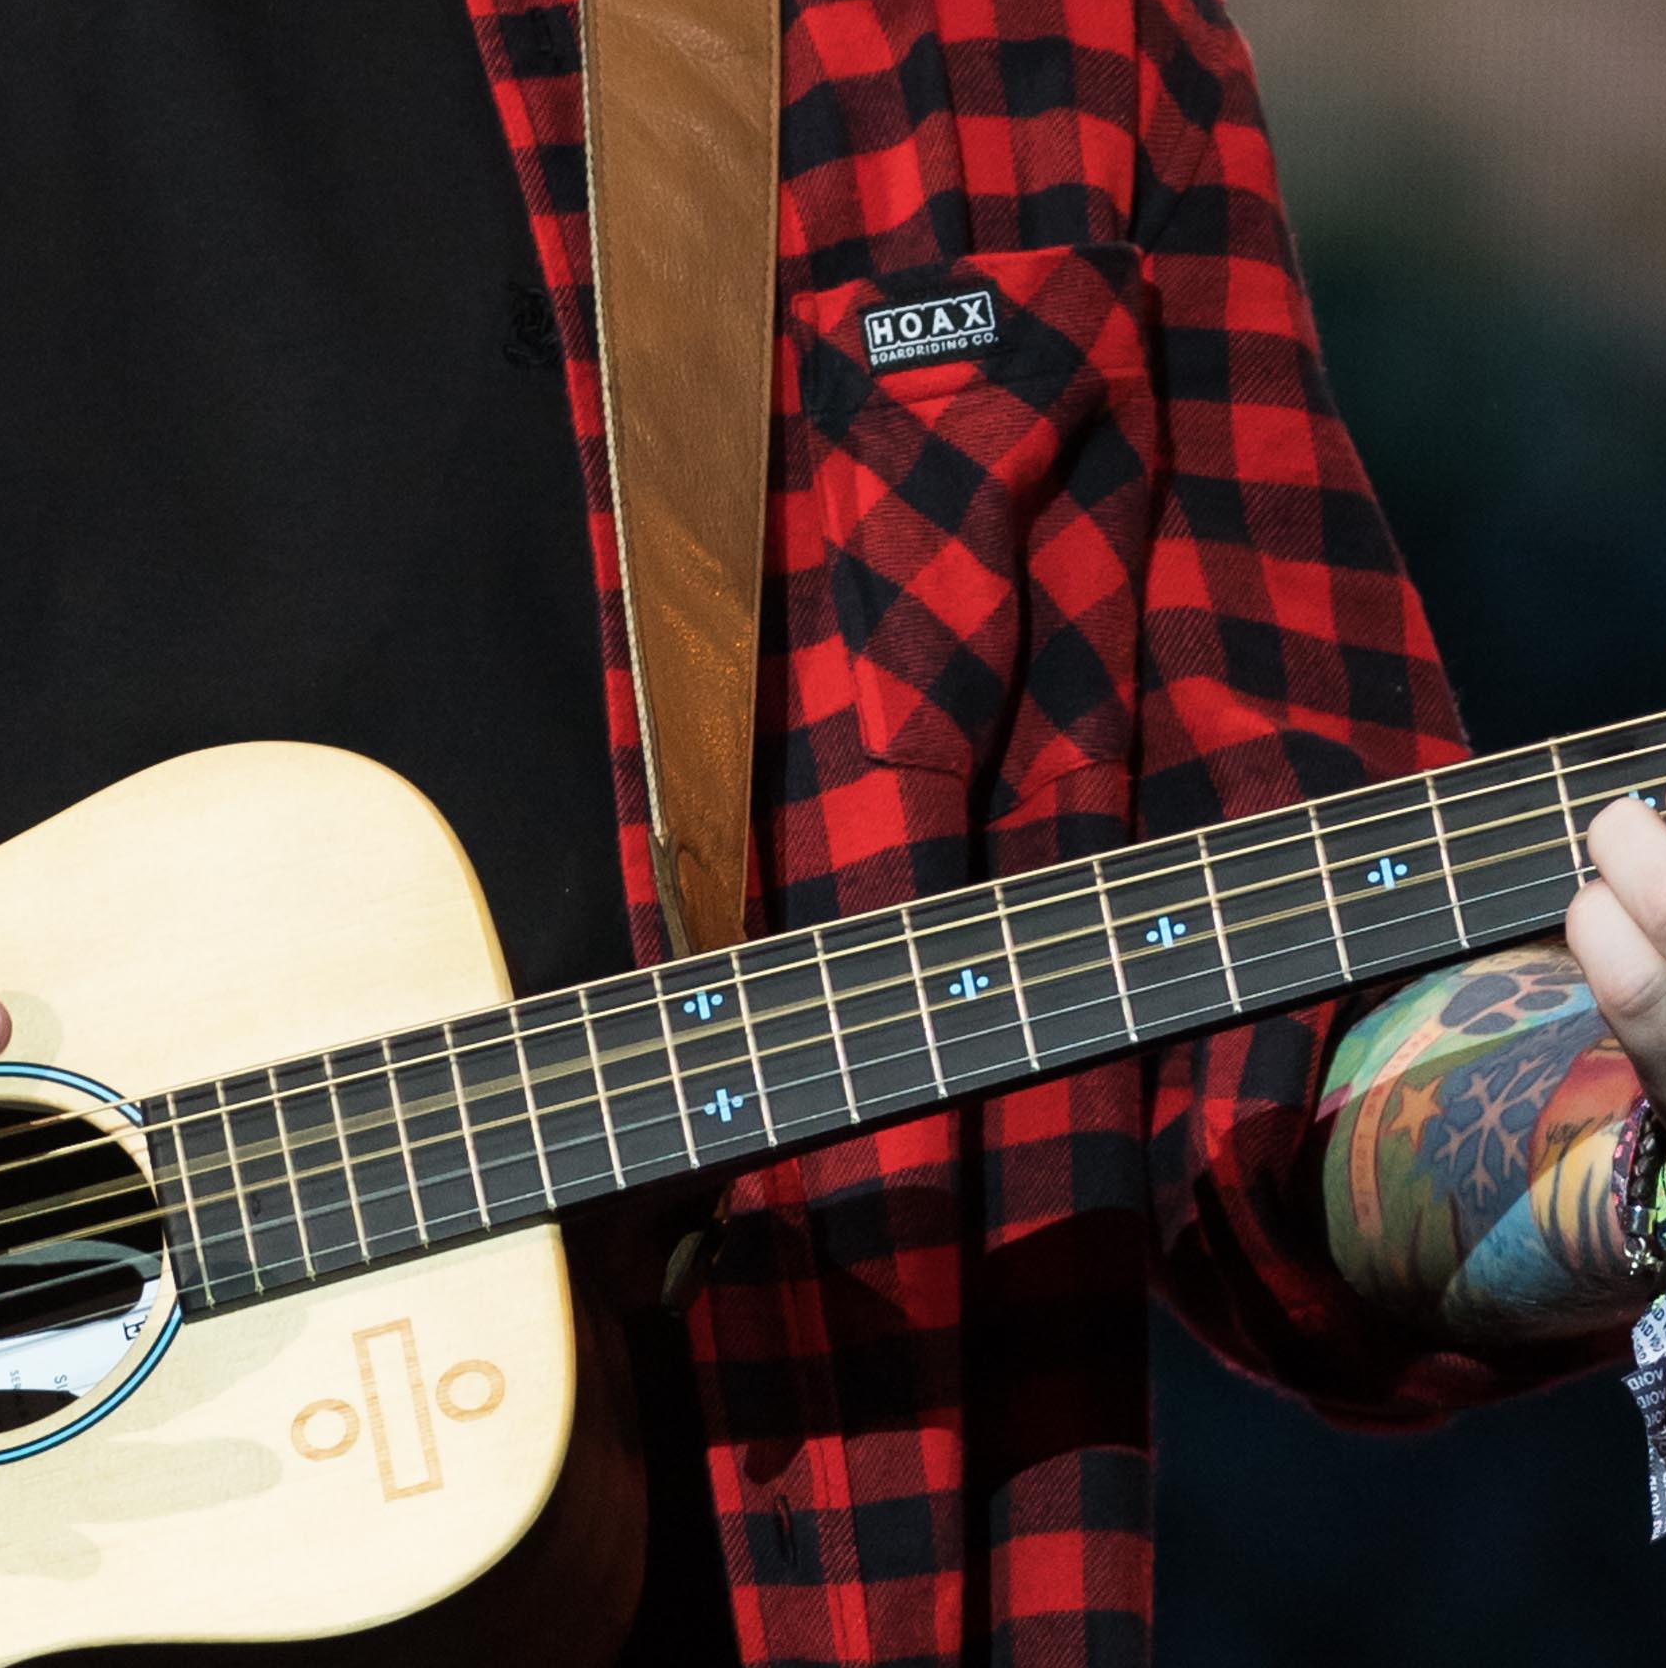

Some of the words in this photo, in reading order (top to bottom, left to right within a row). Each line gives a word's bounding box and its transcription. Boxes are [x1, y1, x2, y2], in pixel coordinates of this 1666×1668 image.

[871, 299, 987, 346] HOAX
[869, 338, 969, 366] BOARDRIDING
[971, 332, 1000, 346] CO.
